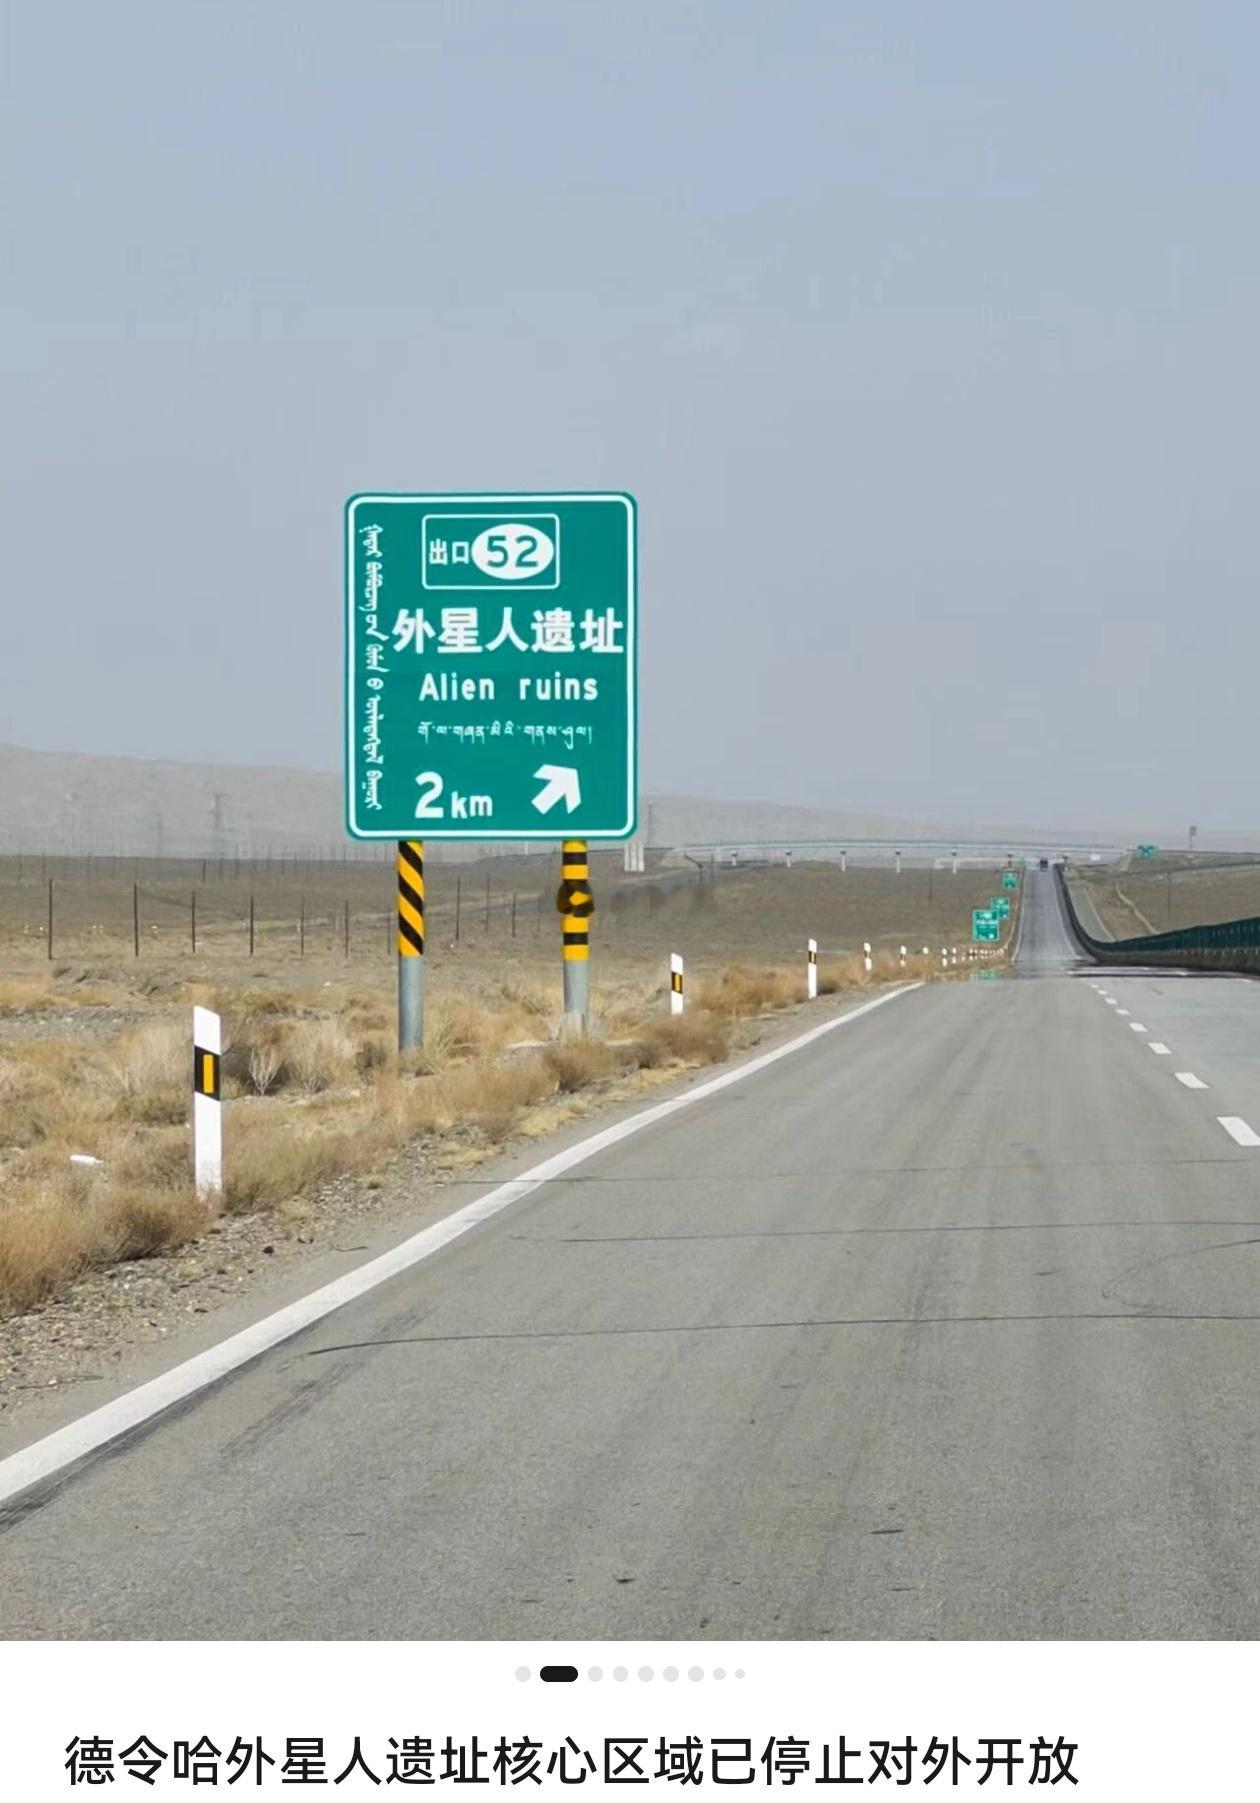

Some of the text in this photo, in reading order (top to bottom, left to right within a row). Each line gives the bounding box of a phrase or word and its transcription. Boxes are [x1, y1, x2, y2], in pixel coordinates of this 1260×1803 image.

[429, 535, 538, 568] 出口 52
[392, 607, 624, 654] 外星人遗址
[419, 671, 598, 701] Alien ruins
